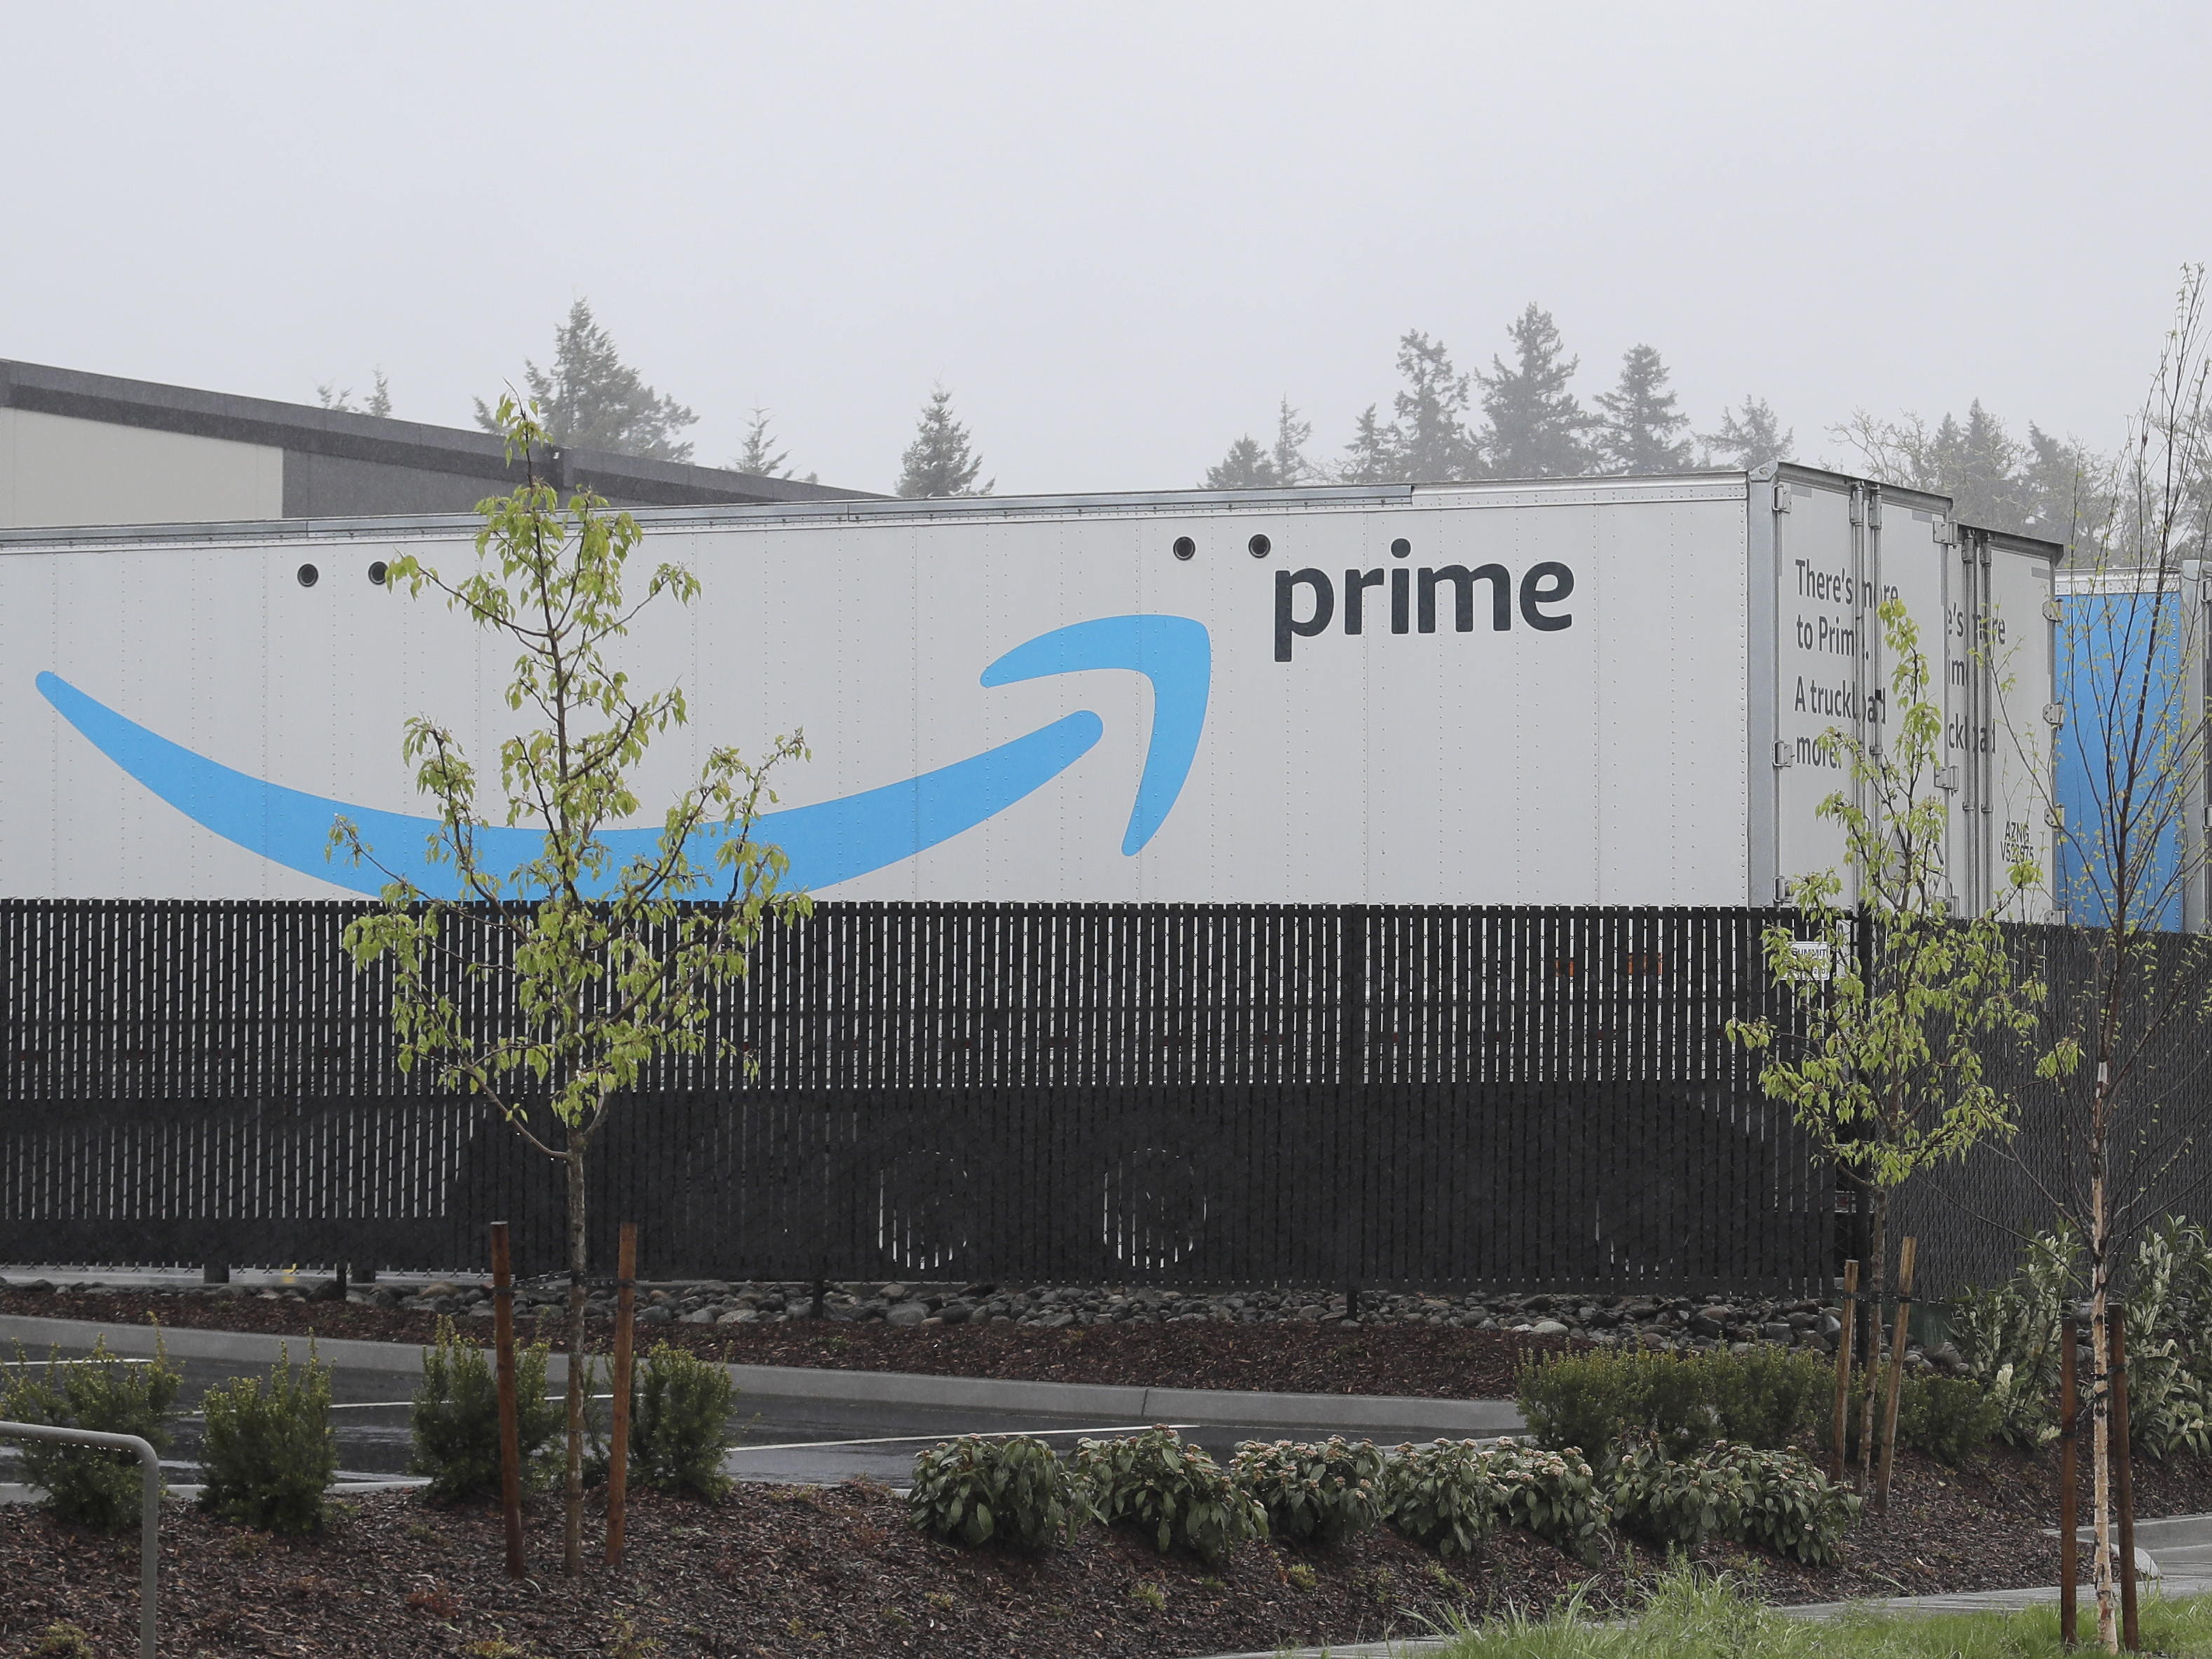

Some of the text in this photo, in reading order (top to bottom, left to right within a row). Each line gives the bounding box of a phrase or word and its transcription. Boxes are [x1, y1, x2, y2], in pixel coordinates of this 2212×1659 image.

[1274, 538, 1574, 662] prime
[1795, 558, 1853, 605] There's
[1796, 614, 1870, 661] to Prim.
[1795, 676, 1807, 713] A
